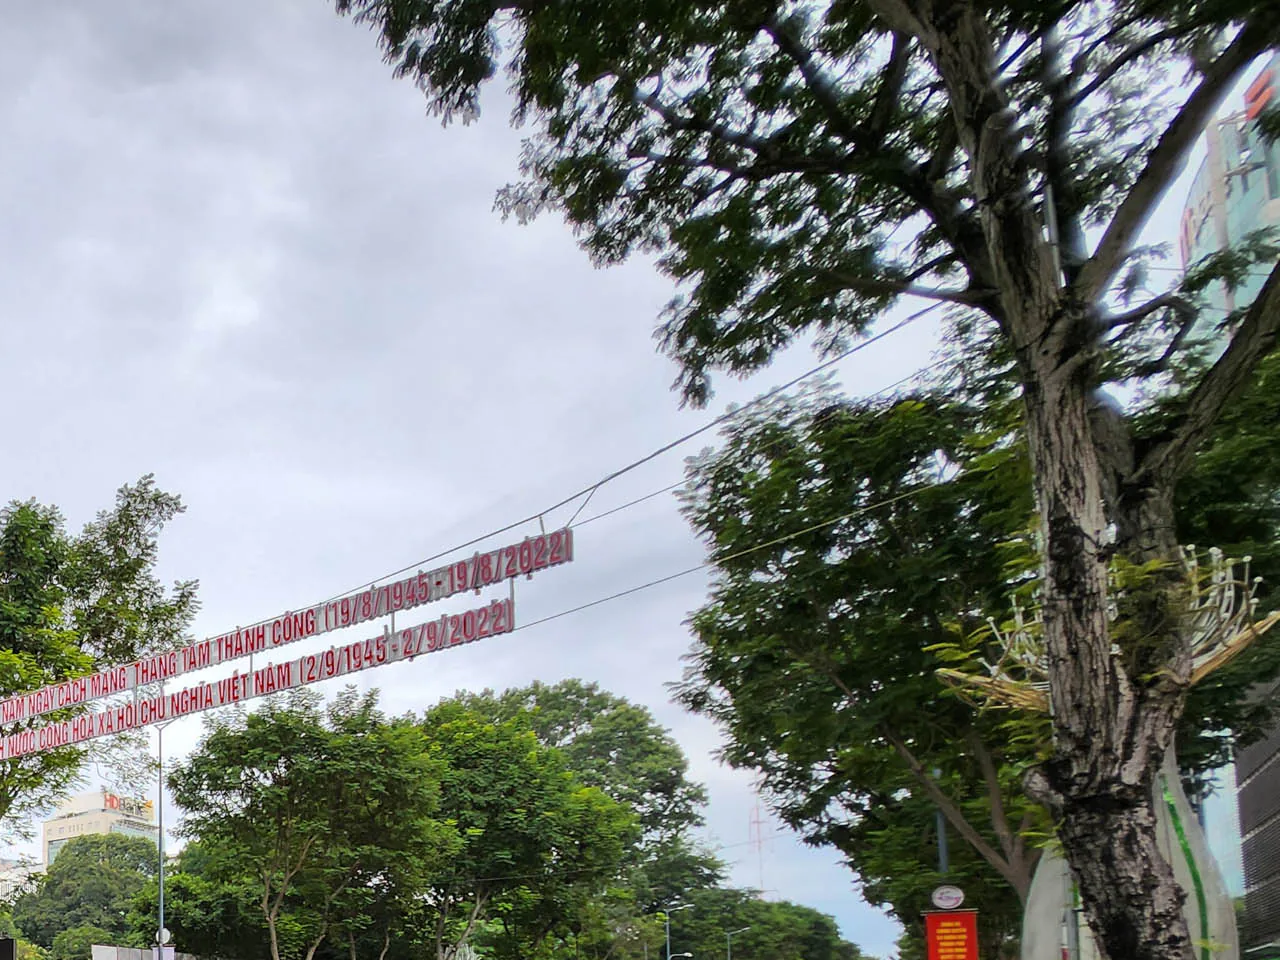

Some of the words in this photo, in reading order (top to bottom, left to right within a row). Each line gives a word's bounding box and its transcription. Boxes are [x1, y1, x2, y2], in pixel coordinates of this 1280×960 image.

[216, 626, 265, 662] THÀNH
[272, 610, 314, 646] CÔNG
[324, 572, 429, 631] (19/8/1945
[447, 527, 571, 593] 19/8/2022)
[170, 680, 212, 719] NGHĨA
[217, 670, 247, 707] VIỆT
[299, 635, 386, 683] (2/9/1945
[402, 601, 513, 655] 2/9/2022)
